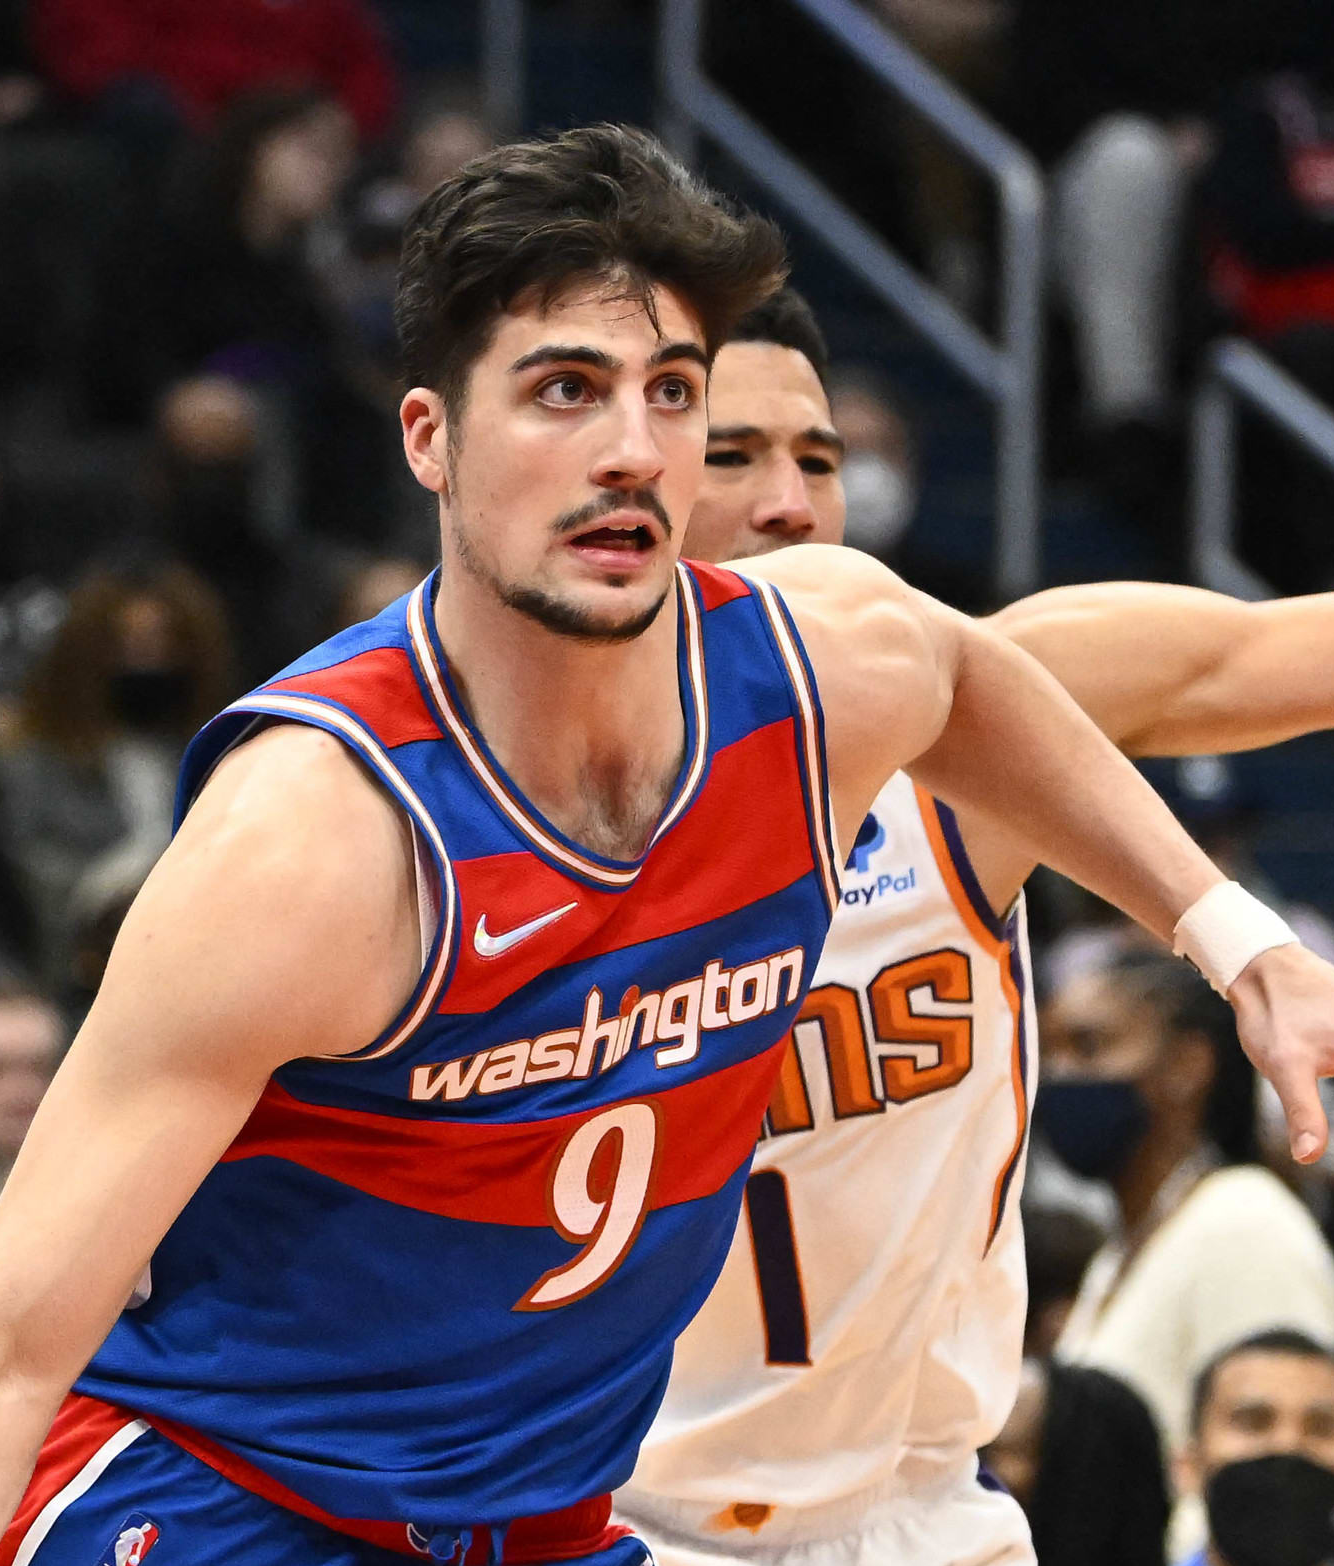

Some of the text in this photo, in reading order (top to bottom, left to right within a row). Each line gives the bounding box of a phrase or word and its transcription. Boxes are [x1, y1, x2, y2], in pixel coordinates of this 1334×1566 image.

[839, 867, 916, 905] ayPal
[410, 945, 805, 1102] washington
[511, 1099, 666, 1312] 9
[746, 1166, 812, 1366] 1
